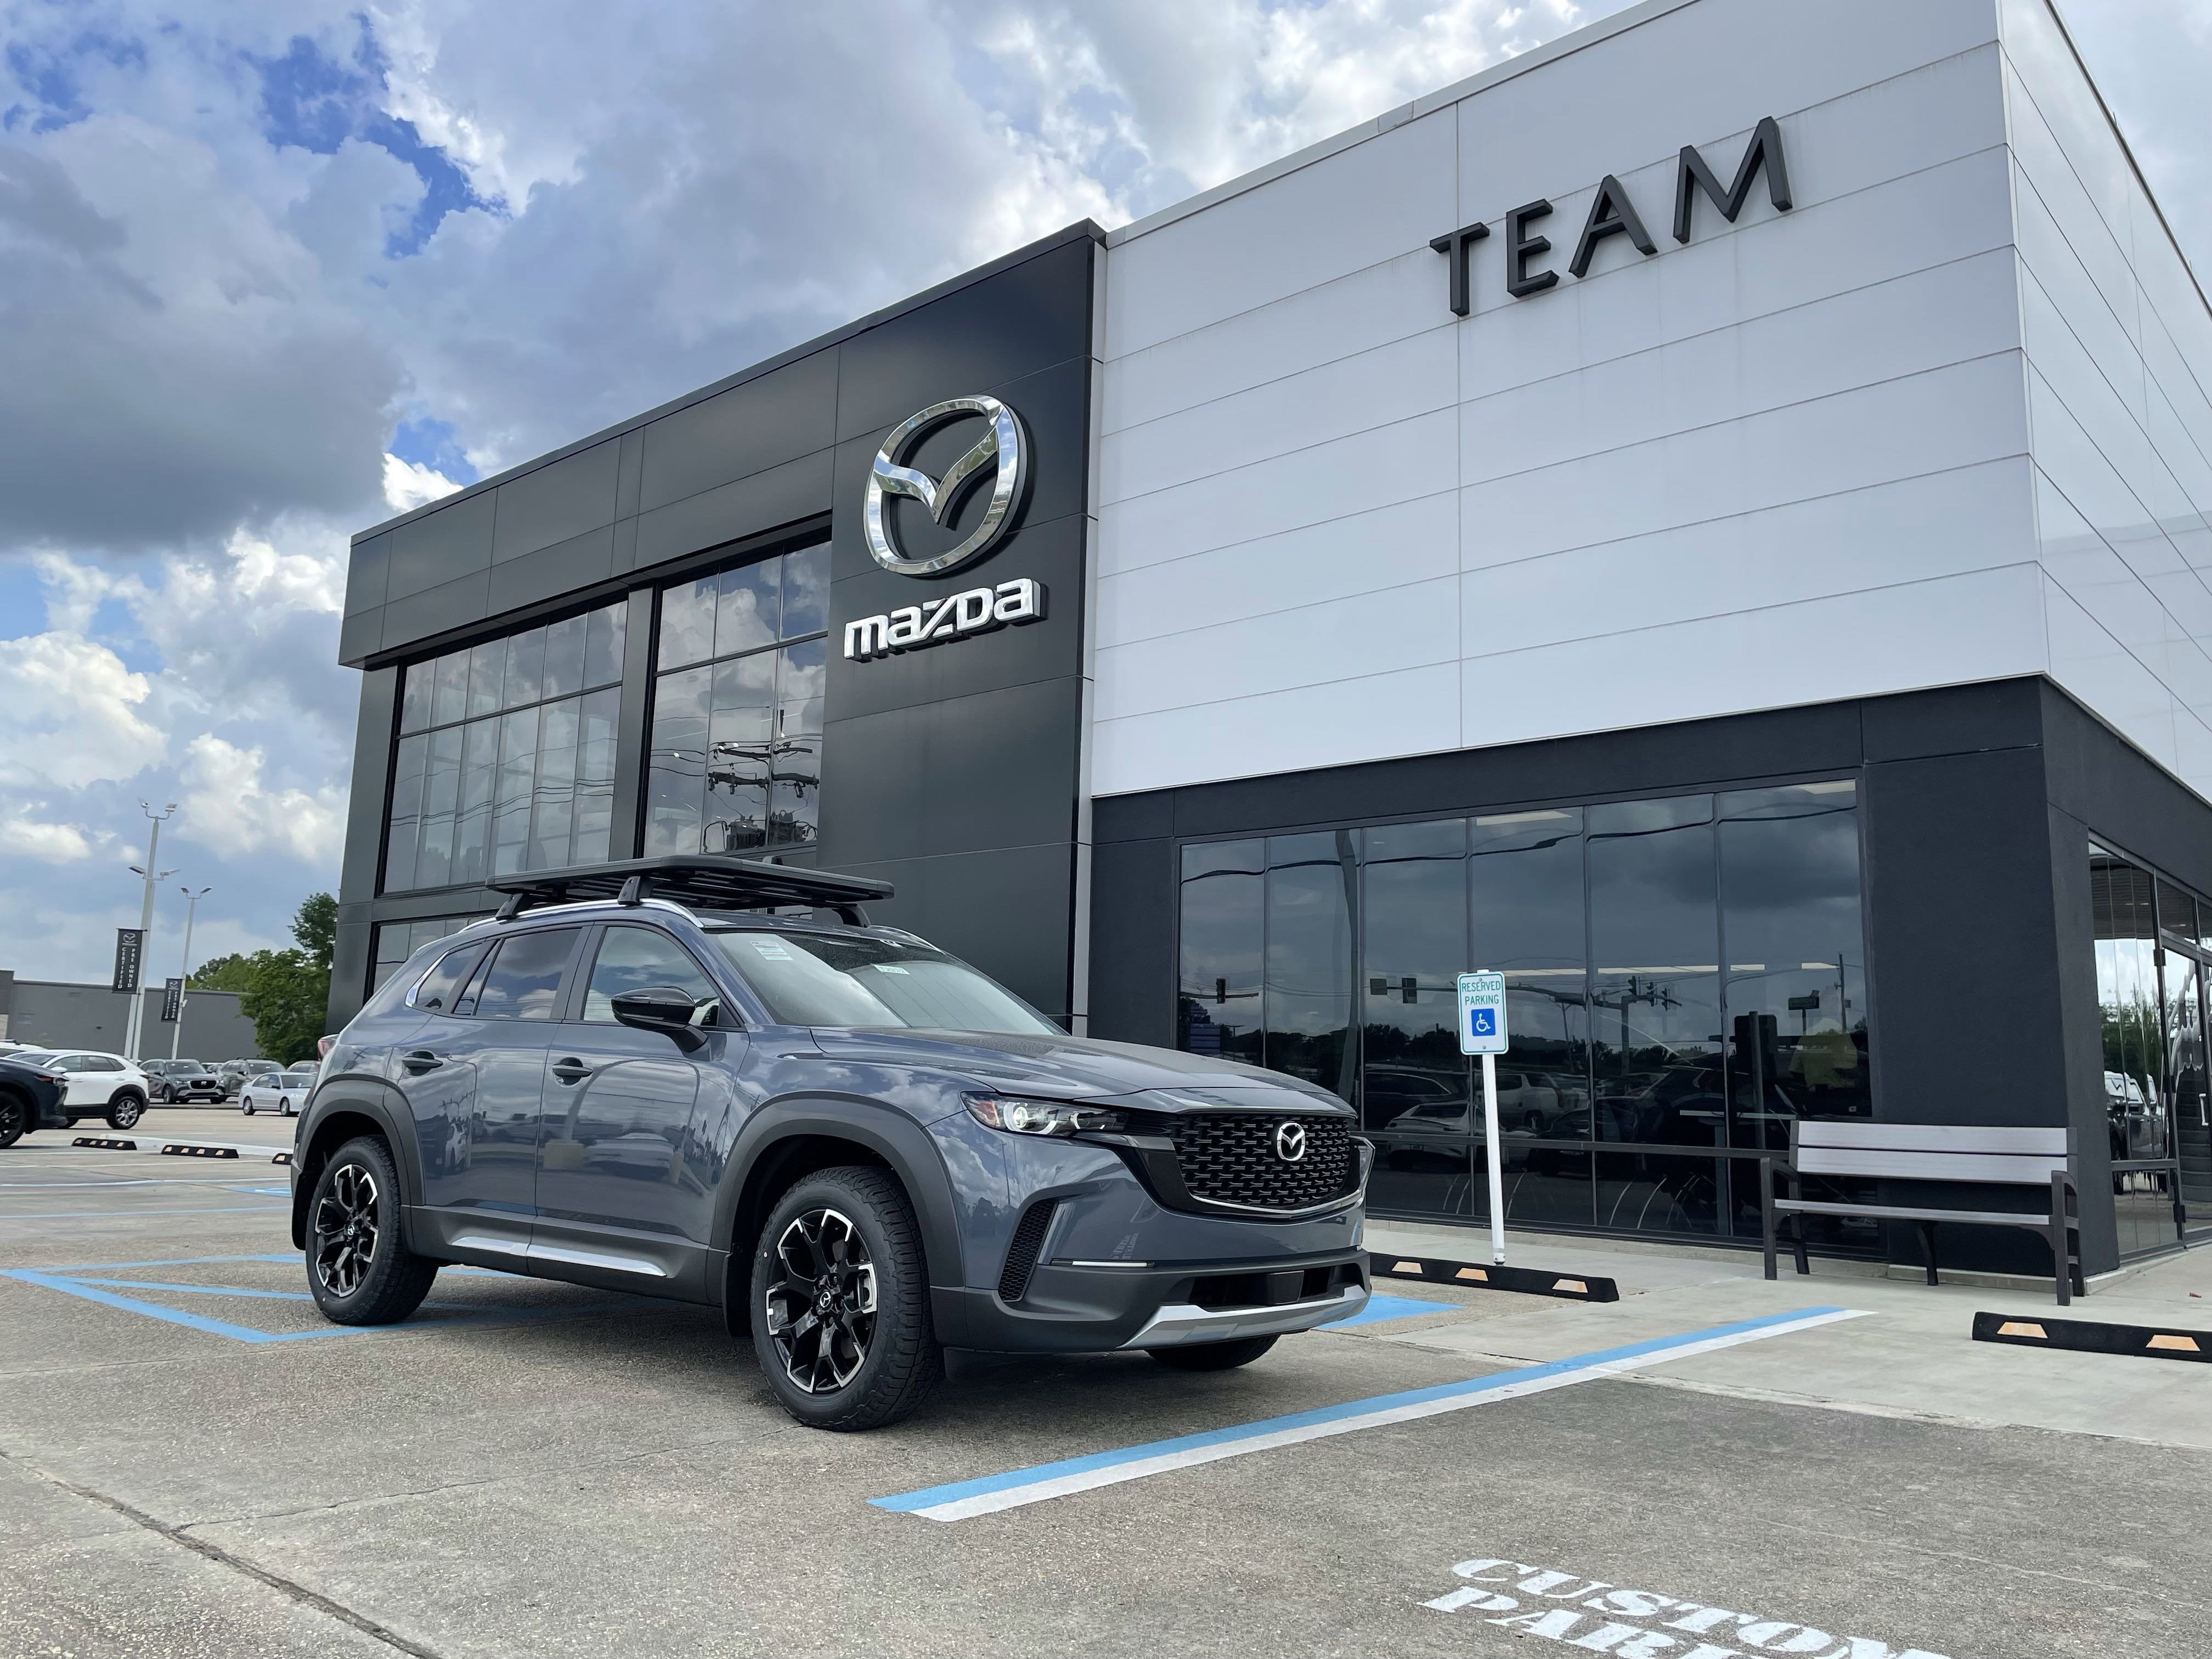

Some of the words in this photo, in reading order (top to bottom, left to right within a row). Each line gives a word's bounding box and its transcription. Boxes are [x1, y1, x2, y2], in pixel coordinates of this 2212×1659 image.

[1429, 115, 1793, 317] TEAM
[117, 947, 127, 989] CERTIFIED
[1462, 980, 1501, 992] RESERVED
[1464, 994, 1499, 1006] PARKING
